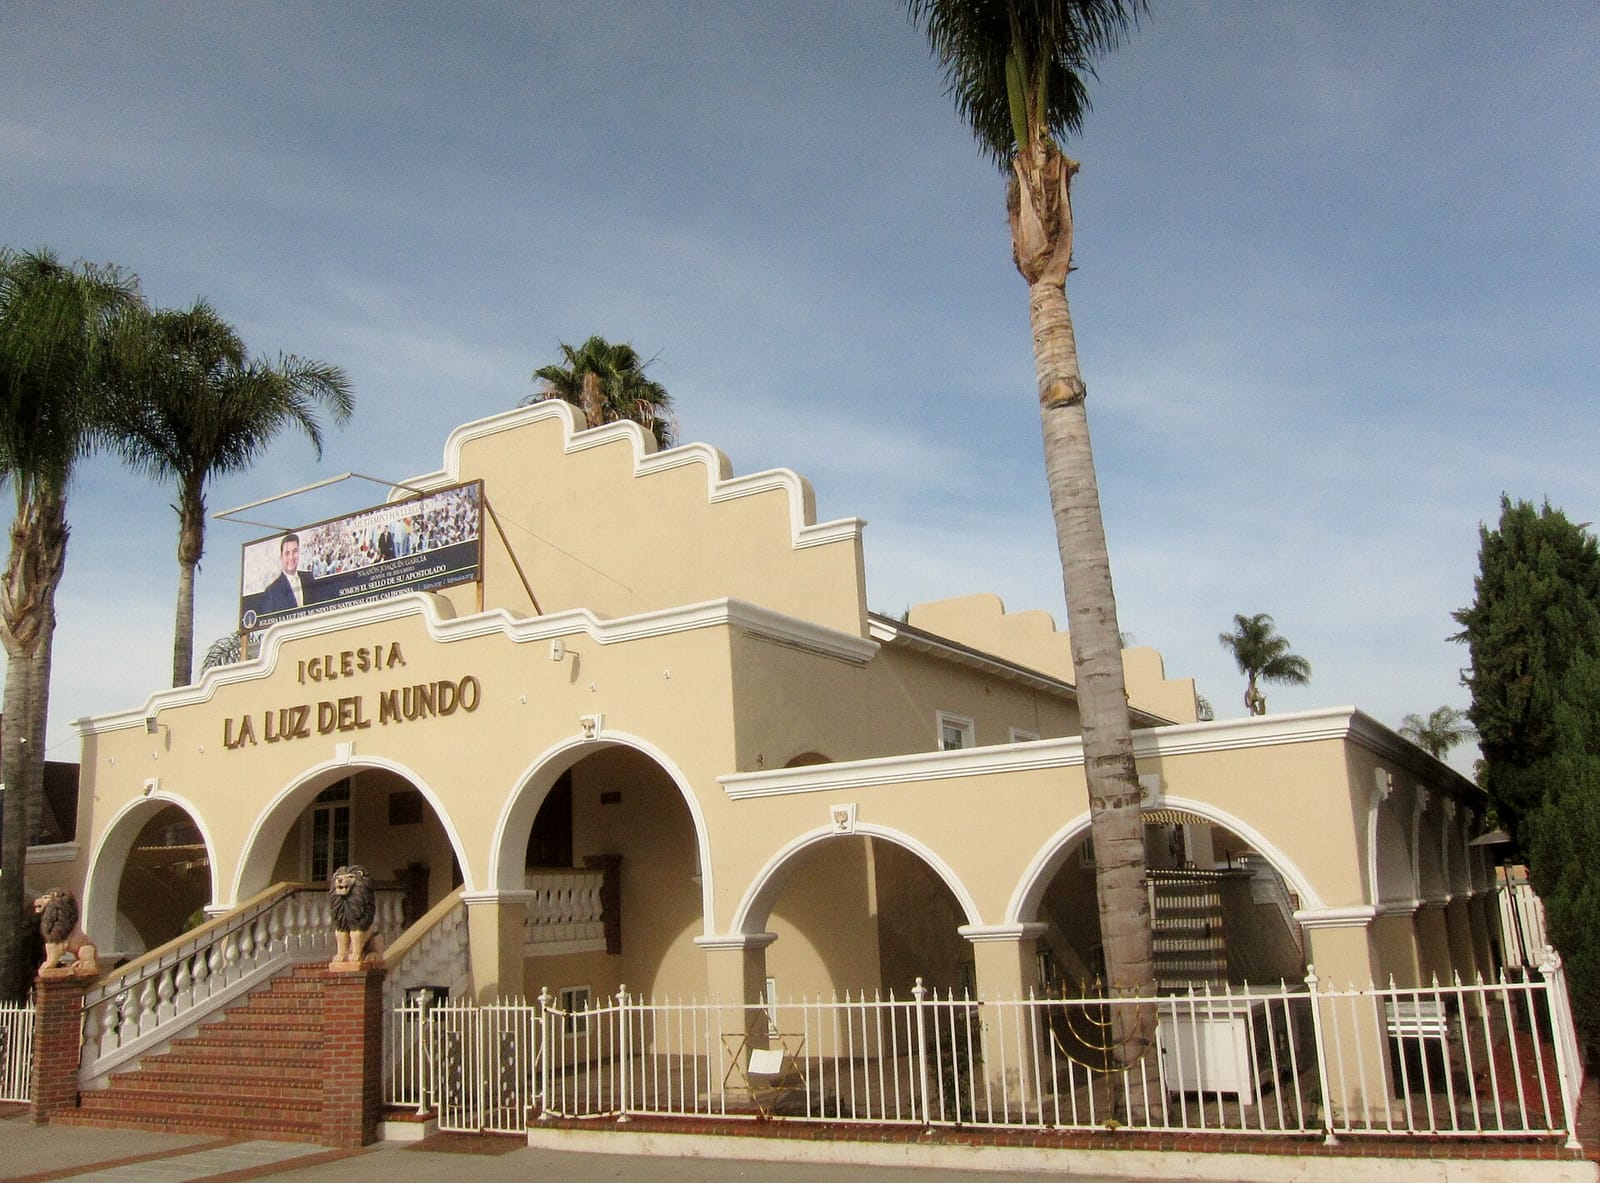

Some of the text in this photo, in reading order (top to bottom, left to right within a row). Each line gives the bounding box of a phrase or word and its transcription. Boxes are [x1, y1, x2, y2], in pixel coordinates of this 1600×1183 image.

[339, 586, 360, 596] SOMOS
[368, 579, 387, 590] SELLO
[387, 577, 396, 586] DE
[396, 575, 405, 583] SU
[405, 564, 447, 580] APOSTOLADO
[307, 606, 329, 617] MUNDO
[337, 598, 365, 610] NATIONAL
[380, 587, 414, 600] CALIFORNIA
[297, 642, 407, 685] IGLESIA
[223, 675, 482, 750] LA LUZ DEL MUNDO
